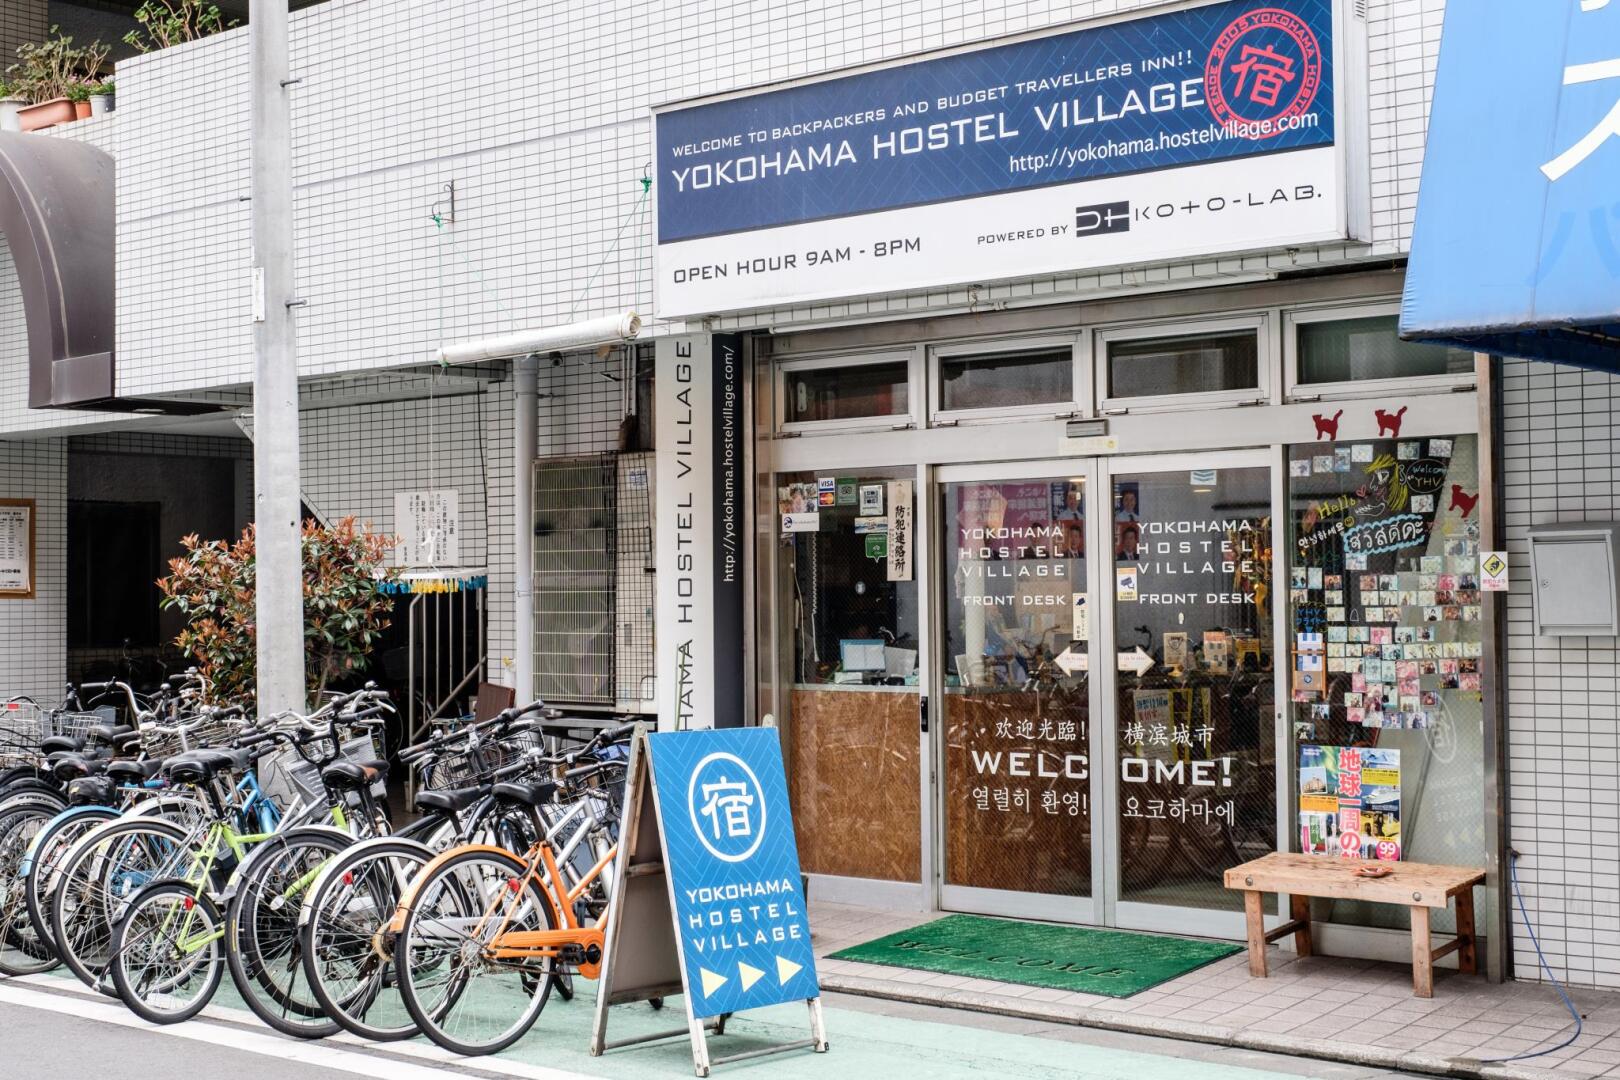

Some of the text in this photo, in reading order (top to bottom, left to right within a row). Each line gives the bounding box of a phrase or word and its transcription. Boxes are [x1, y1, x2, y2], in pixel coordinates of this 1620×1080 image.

[1251, 12, 1315, 59] YOKOHAMA
[1230, 44, 1296, 107] 宿
[672, 50, 1192, 157] WELCOME TO BACKPACKERS AND BUDGET TRAVELLERS INN!!
[672, 77, 1205, 192] YOKOHAMA HOSTEL VILLAGE
[1010, 112, 1318, 173] http://yokohama.hostelvillage.com
[977, 228, 1045, 246] POWERED
[1051, 225, 1068, 237] BY
[674, 263, 728, 284] OPEN
[737, 254, 797, 276] HOUR
[806, 247, 851, 266] 9AM
[874, 237, 921, 257] 8PM
[723, 345, 736, 582] http://yokohama.hostelvillage.com/
[820, 480, 834, 488] VISA
[1415, 476, 1442, 488] YHV
[1317, 494, 1357, 521] Hello
[676, 341, 693, 731] HAMA HOSTEL VILLAGE
[961, 526, 1064, 540] YOKOHAMA
[1136, 519, 1253, 534] YOKOHAMA
[960, 545, 1064, 559] HOSTEL
[1136, 540, 1253, 554] HOSTEL
[960, 564, 1065, 578] VILLAGE
[1137, 560, 1253, 575] VILLAGE
[963, 594, 1067, 606] FRONT DESK
[1139, 592, 1256, 605] FRONT DESK
[995, 716, 1086, 741] 欢迎光臨!
[1123, 721, 1216, 749] 横滨城市
[971, 750, 1232, 787] WELCOME!
[700, 775, 754, 840] 宿
[972, 785, 1087, 816] 열렬히 환영!
[1122, 795, 1235, 827] 요코하마에
[1380, 842, 1396, 854] 99
[686, 878, 794, 904] YOKOHAMA
[688, 901, 798, 929] HOSTEL
[693, 924, 801, 953] VILLAGE
